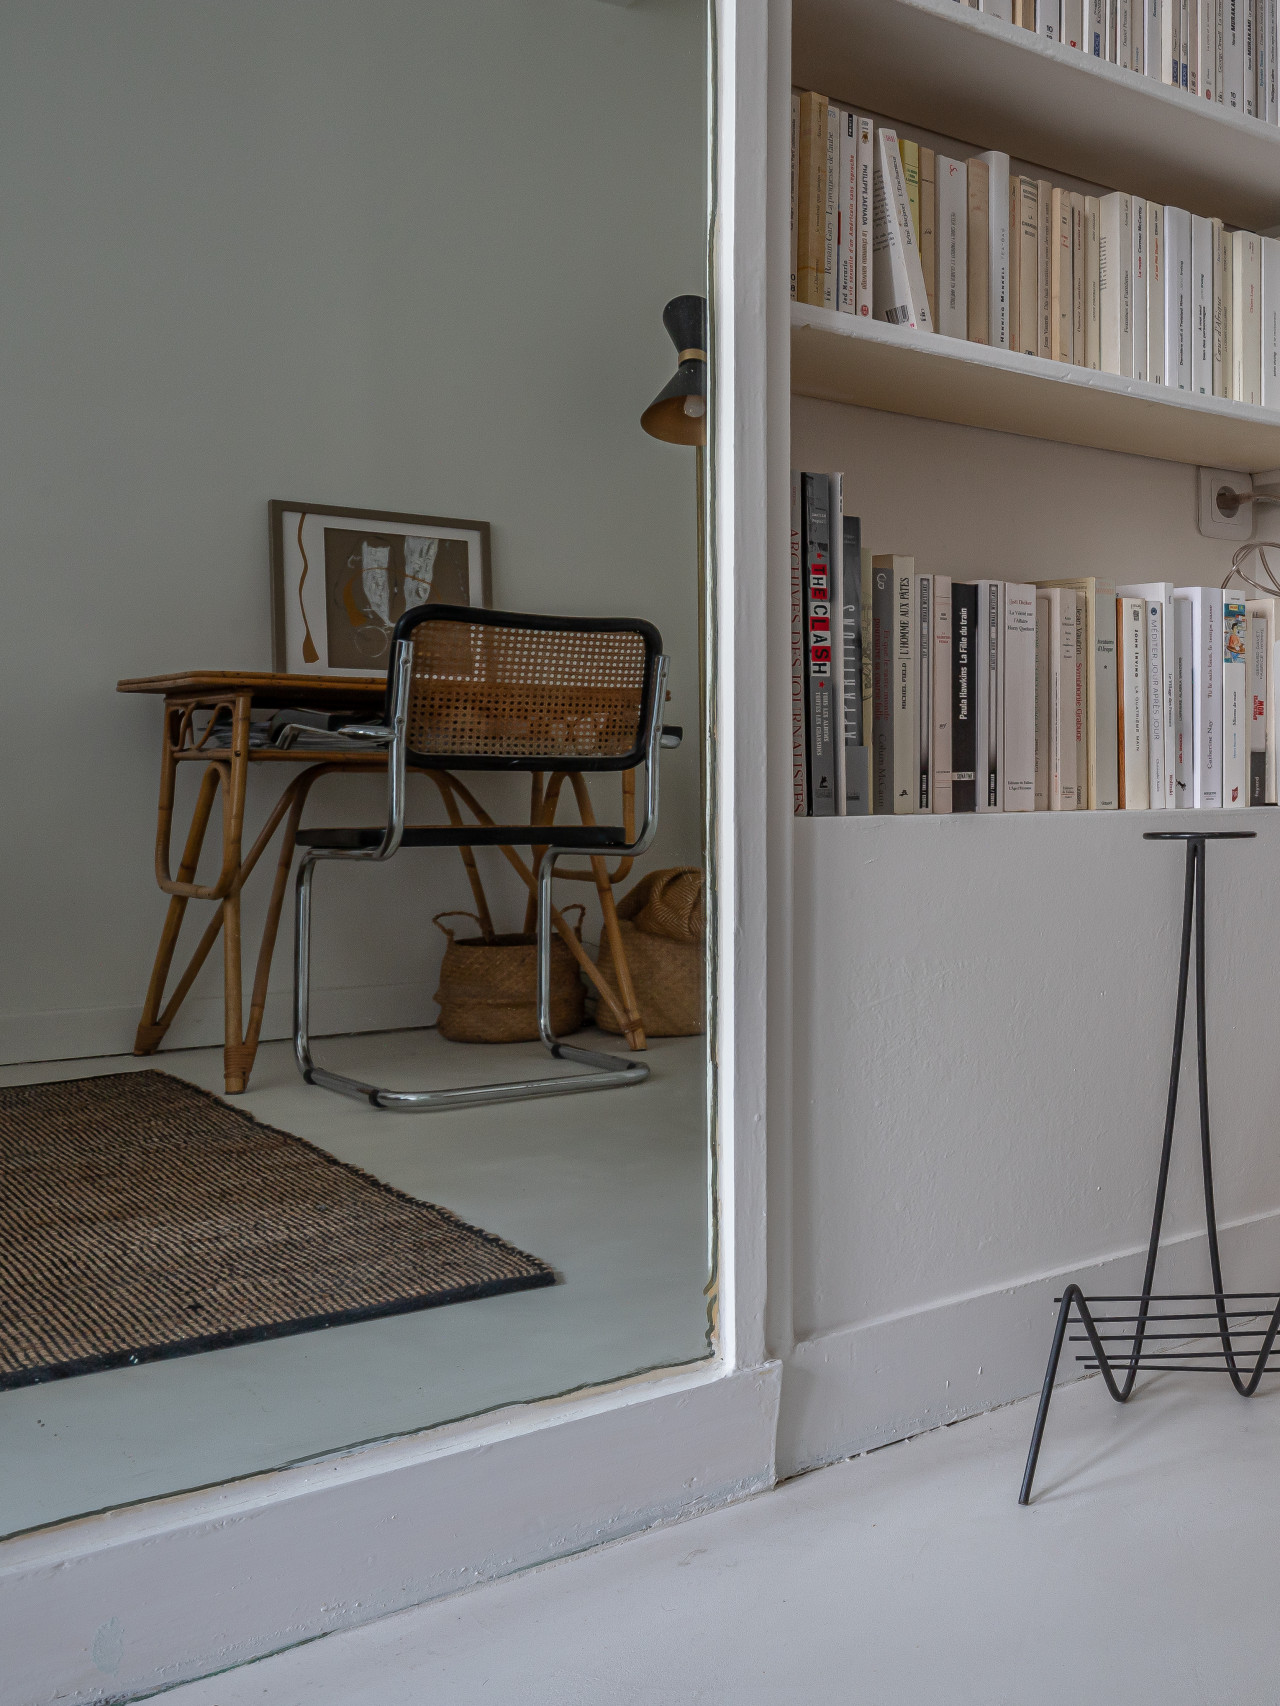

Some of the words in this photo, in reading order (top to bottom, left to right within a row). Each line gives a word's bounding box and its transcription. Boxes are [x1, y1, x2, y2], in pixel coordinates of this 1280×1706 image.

[827, 155, 833, 165] de
[826, 166, 834, 203] promesse
[825, 205, 833, 215] La
[900, 202, 910, 228] Barjavel
[825, 222, 834, 242] Gary
[847, 296, 854, 306] La
[1215, 296, 1223, 335] d'Afrique
[791, 528, 801, 623] ARCHIVES
[811, 564, 828, 600] THE
[898, 577, 910, 601] PÂTES
[900, 602, 909, 618] AUX
[959, 608, 967, 626] train
[810, 602, 830, 677] CLASH
[873, 618, 882, 656] poursuivre
[883, 630, 890, 638] Et
[899, 620, 909, 655] L'HOMME
[959, 626, 967, 636] du
[1019, 625, 1035, 633] Quebert
[791, 629, 802, 668] DES
[882, 641, 890, 658] que
[959, 637, 967, 653] Fille
[874, 658, 881, 668] sa
[959, 654, 967, 664] La
[843, 603, 857, 740] APPARITIONS
[959, 666, 968, 698] Hawkins
[1151, 662, 1159, 686] JOUR
[1075, 662, 1083, 707] Symphonie
[1134, 685, 1140, 694] LA
[1207, 690, 1212, 698] Tu
[874, 702, 882, 721] folle
[959, 699, 968, 720] Paula
[1152, 687, 1161, 715] APRÈS
[1152, 718, 1160, 741] JOUR
[1206, 719, 1215, 734] Nay
[791, 673, 804, 815] JOURNALISTES
[877, 734, 885, 767] Colum
[877, 768, 886, 808] McCann
